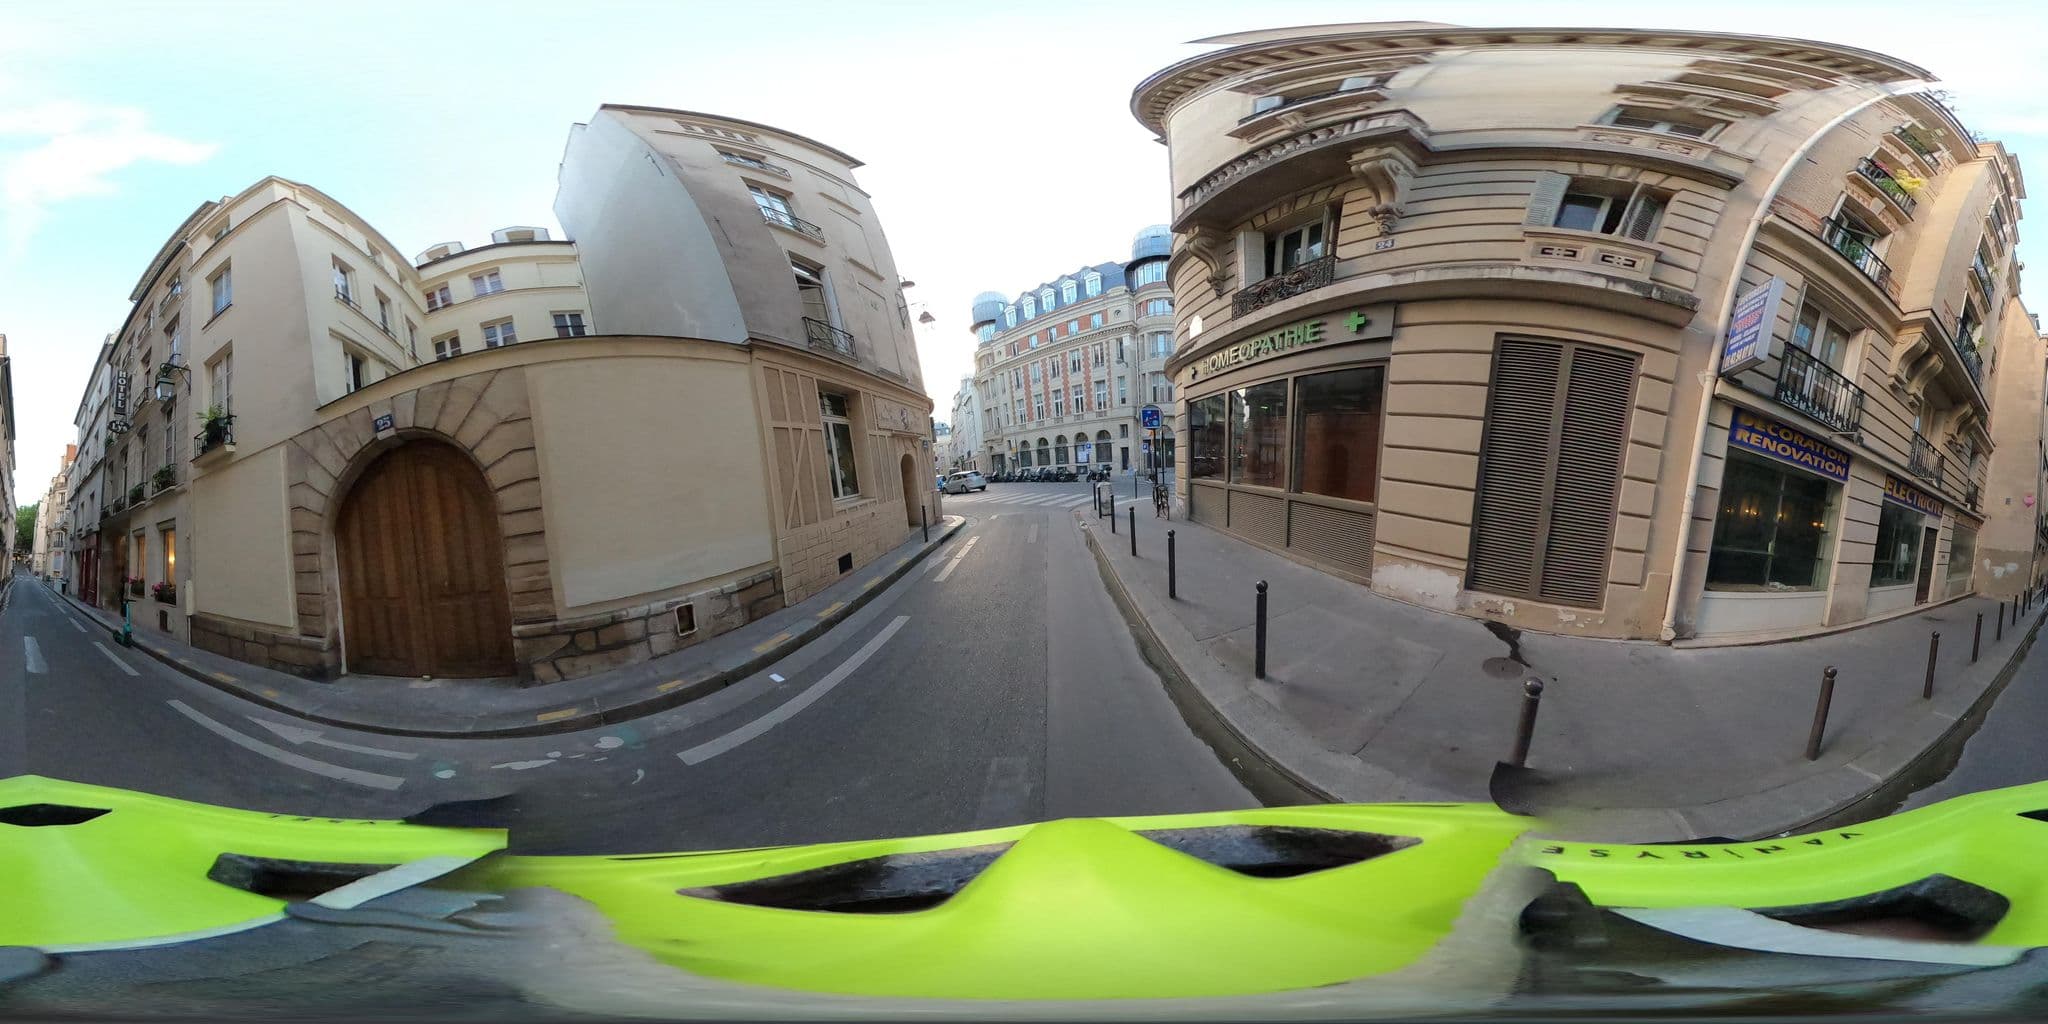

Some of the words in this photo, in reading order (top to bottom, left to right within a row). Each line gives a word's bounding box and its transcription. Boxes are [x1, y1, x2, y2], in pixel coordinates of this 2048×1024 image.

[1377, 241, 1392, 249] 24
[1202, 320, 1322, 374] HOMEOPATHIE
[118, 370, 126, 408] HOTEL
[377, 416, 391, 430] 25
[1738, 413, 1848, 464] DECORATION
[1736, 429, 1846, 477] RENOVATION
[1885, 477, 1943, 517] ELECTRICITE
